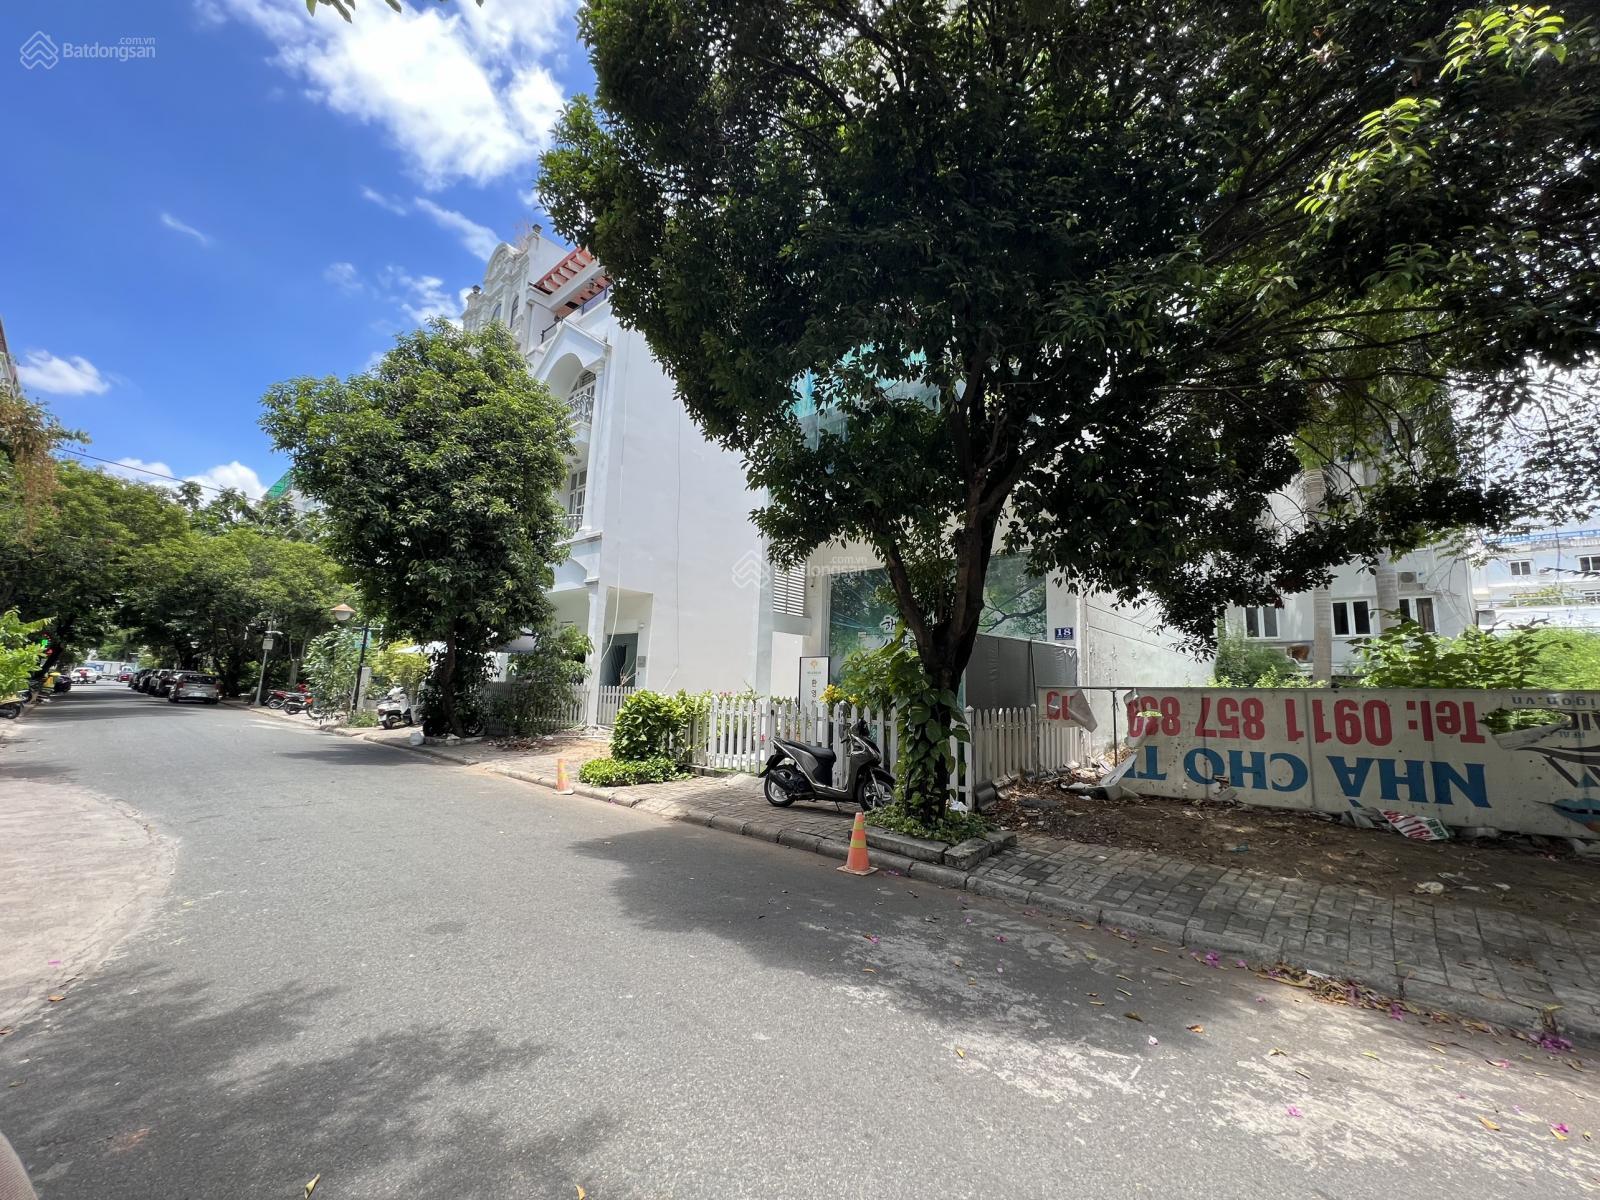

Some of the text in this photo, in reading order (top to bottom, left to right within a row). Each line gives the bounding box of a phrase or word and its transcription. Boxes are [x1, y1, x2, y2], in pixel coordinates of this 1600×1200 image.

[1057, 628, 1072, 636] 18
[1195, 697, 1265, 740] 857
[1285, 699, 1393, 746] 0911
[1406, 700, 1486, 743] Tel:
[1123, 746, 1167, 780] T
[1183, 747, 1309, 792] CHO
